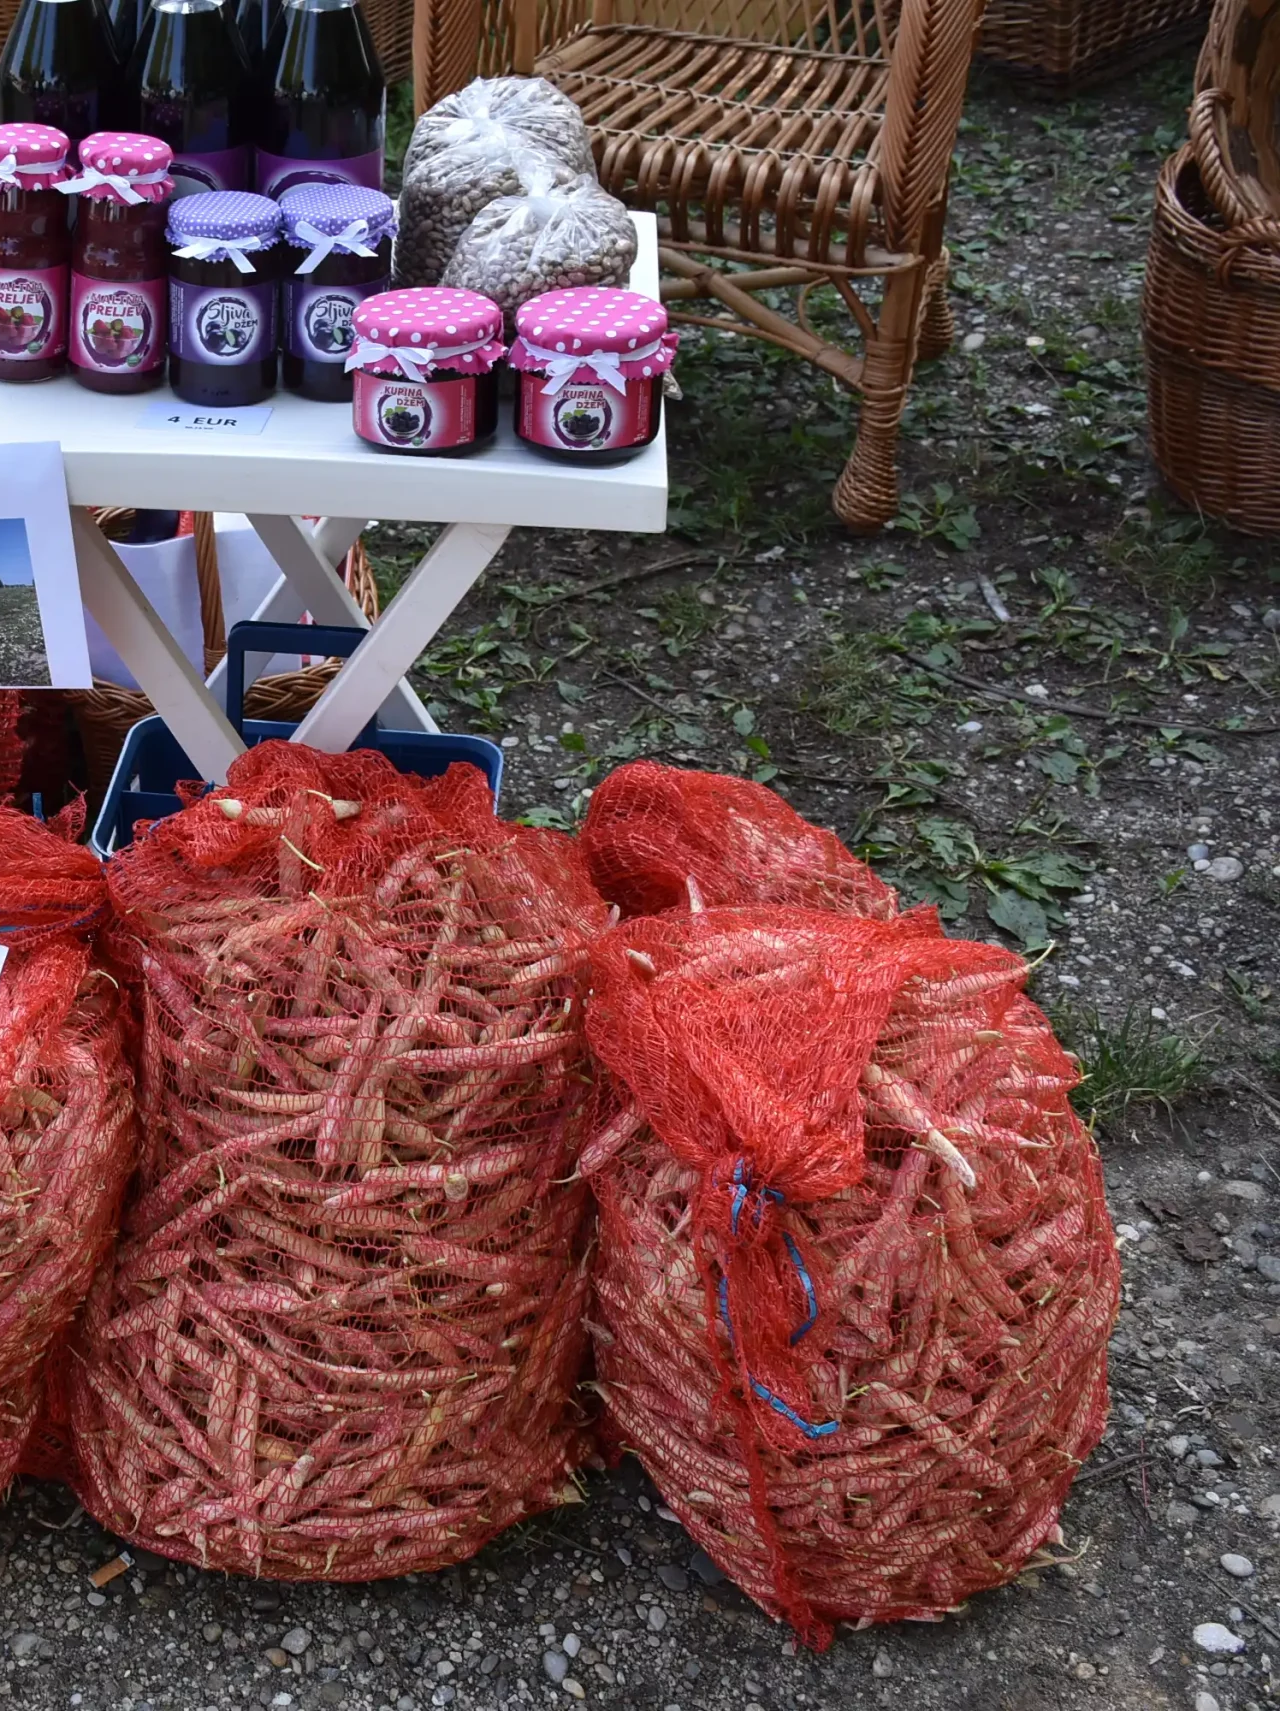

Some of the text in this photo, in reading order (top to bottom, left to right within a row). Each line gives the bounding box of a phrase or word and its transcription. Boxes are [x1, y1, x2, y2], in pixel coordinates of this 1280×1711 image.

[89, 303, 145, 318] PRELJEV
[234, 319, 258, 329] DŽEM
[384, 385, 423, 398] KUPINA
[562, 389, 604, 400] KUPINA
[396, 396, 425, 408] DŽEM
[575, 400, 606, 409] DŽEM
[193, 417, 238, 427] EUR
